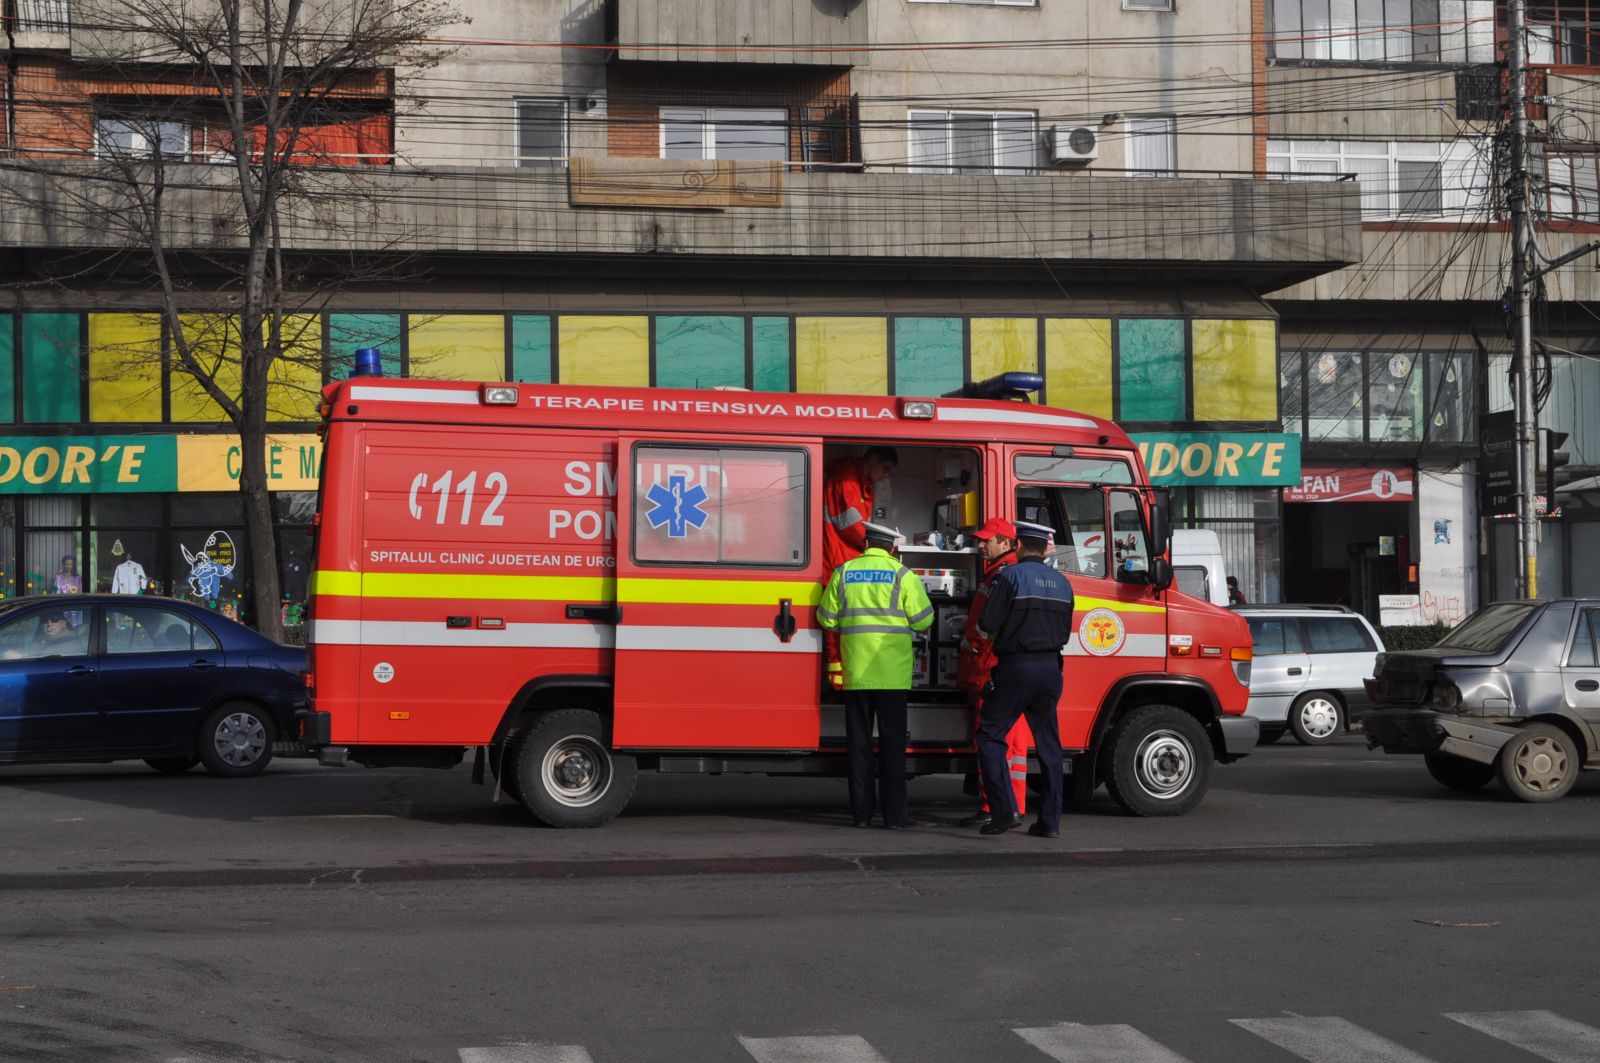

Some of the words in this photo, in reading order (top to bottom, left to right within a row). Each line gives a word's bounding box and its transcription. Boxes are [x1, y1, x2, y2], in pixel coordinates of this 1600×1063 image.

[530, 396, 645, 411] TERAPIE
[653, 400, 788, 416] INTENSIVA
[795, 405, 896, 420] MOBILA
[300, 445, 321, 480] M
[431, 470, 508, 527] 112
[371, 551, 436, 564] SPITALUL
[439, 553, 485, 565] CLINIC
[489, 554, 561, 567] JUDETEAN
[565, 556, 583, 567] DE
[846, 571, 892, 582] POLITIA
